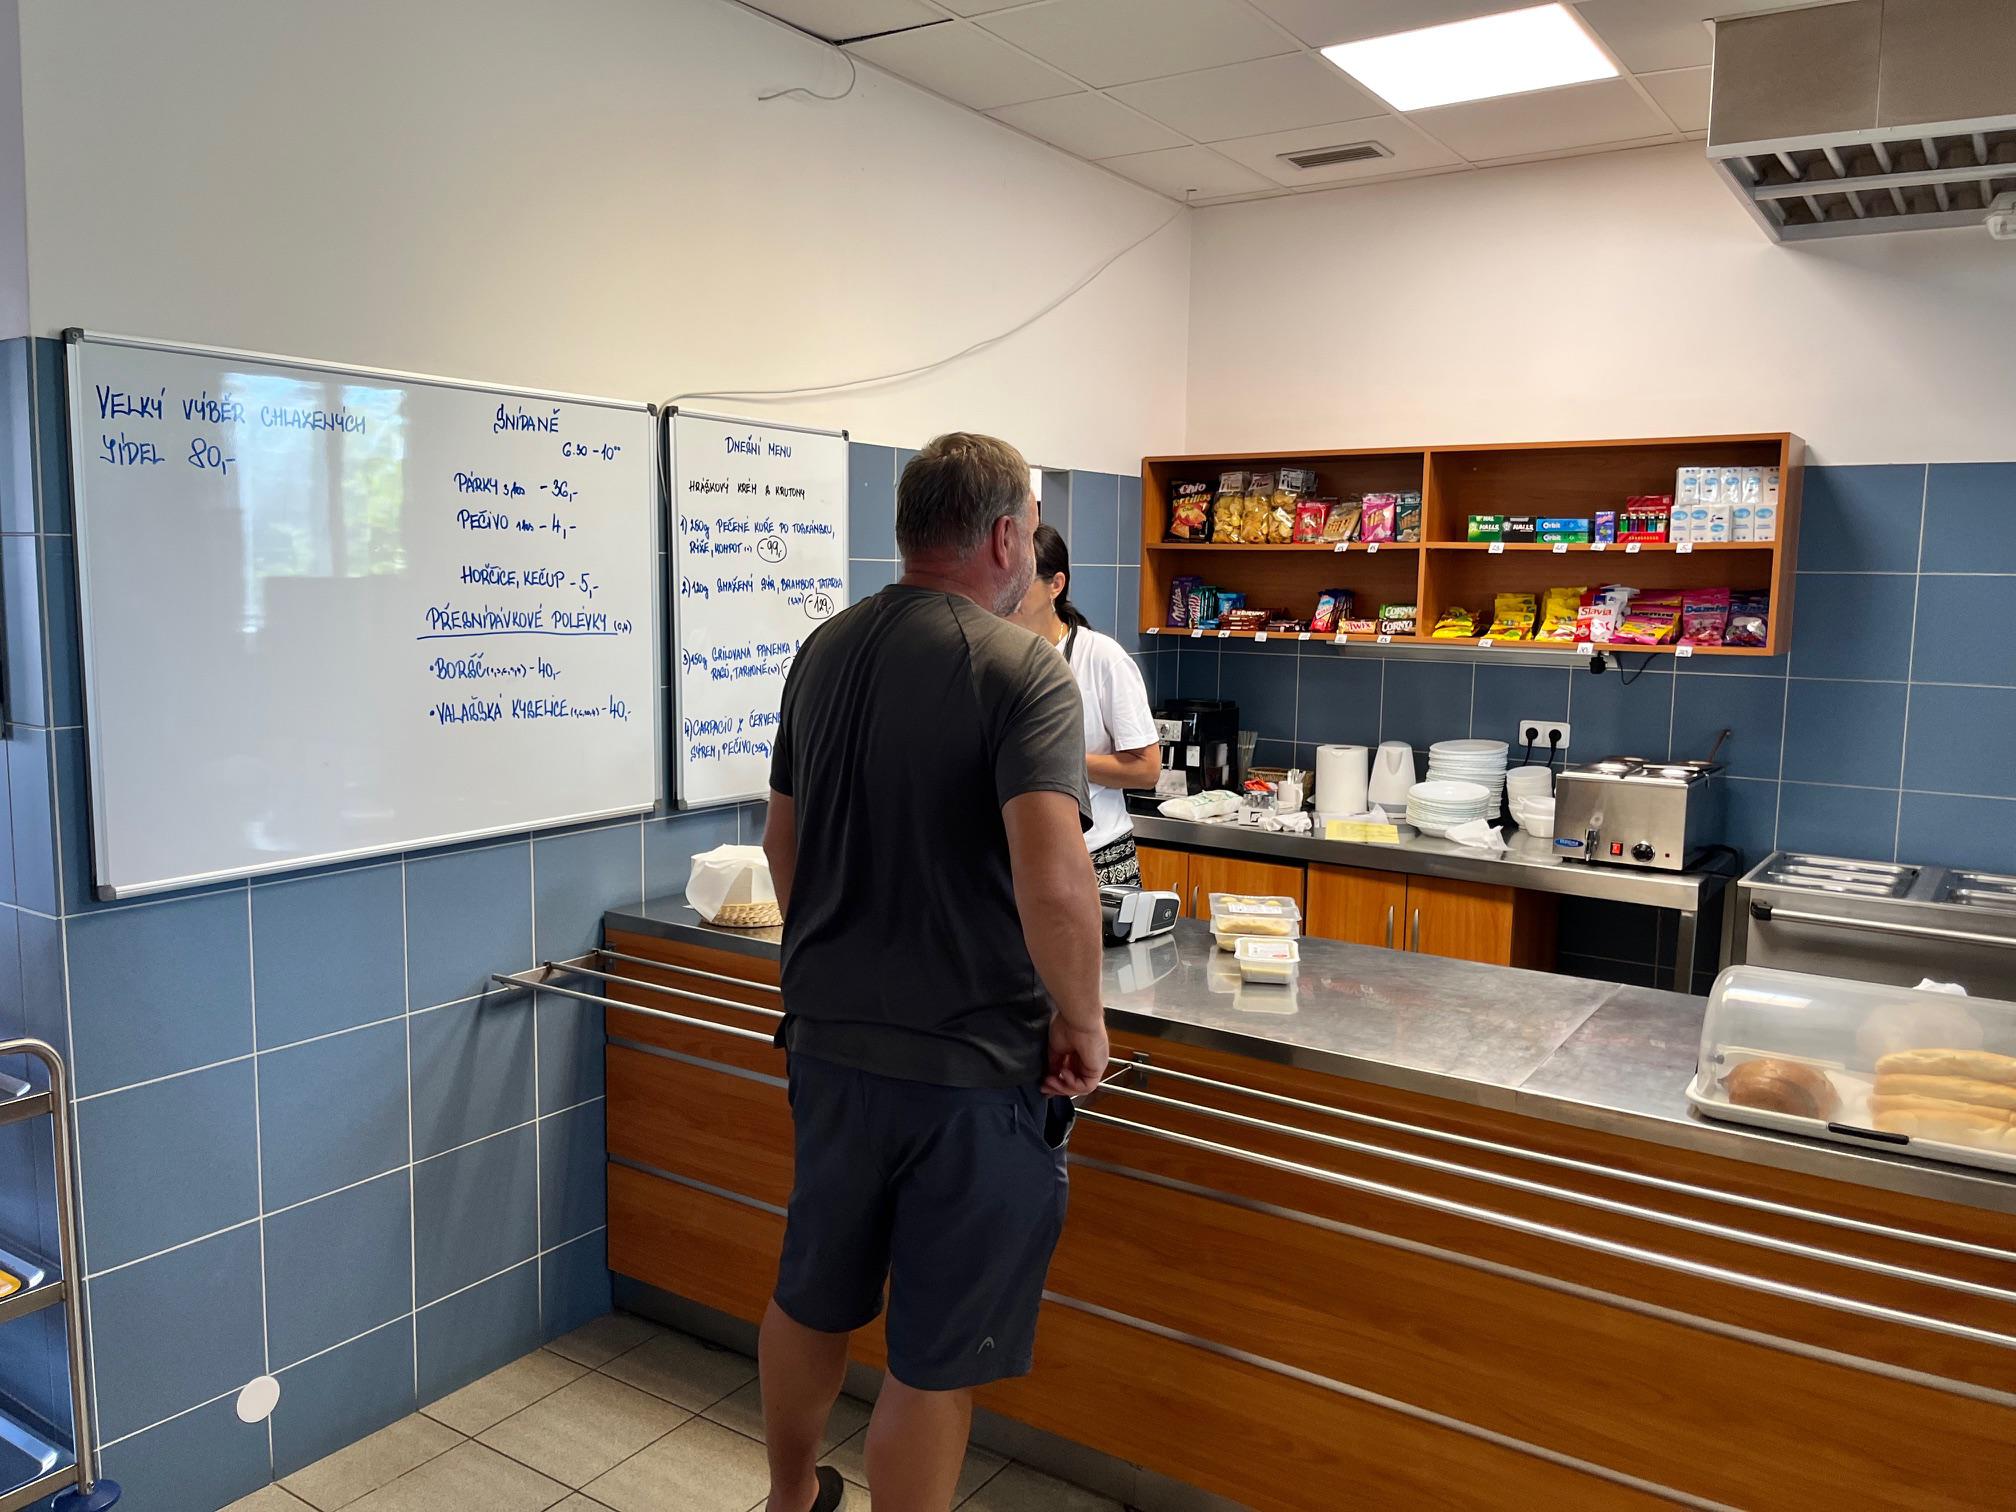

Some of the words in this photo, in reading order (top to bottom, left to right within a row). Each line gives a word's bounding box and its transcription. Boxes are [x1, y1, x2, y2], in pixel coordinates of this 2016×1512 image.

[96, 385, 166, 419] VELKÝ
[183, 391, 245, 423] VÝBĚR
[260, 406, 366, 434] CHLAZENÝCH
[493, 403, 560, 433] SNÍDANĚ
[99, 432, 165, 465] JÍDEL
[725, 435, 762, 456] DNEŠNÍ
[768, 443, 792, 458] MENU
[454, 471, 498, 495] PÁRKY
[457, 509, 509, 530] PEČIVO
[523, 569, 565, 588] KEČUP
[551, 605, 607, 631] POLÉVKY
[1580, 607, 1612, 616] Slavia
[749, 709, 781, 728] ČERVEN
